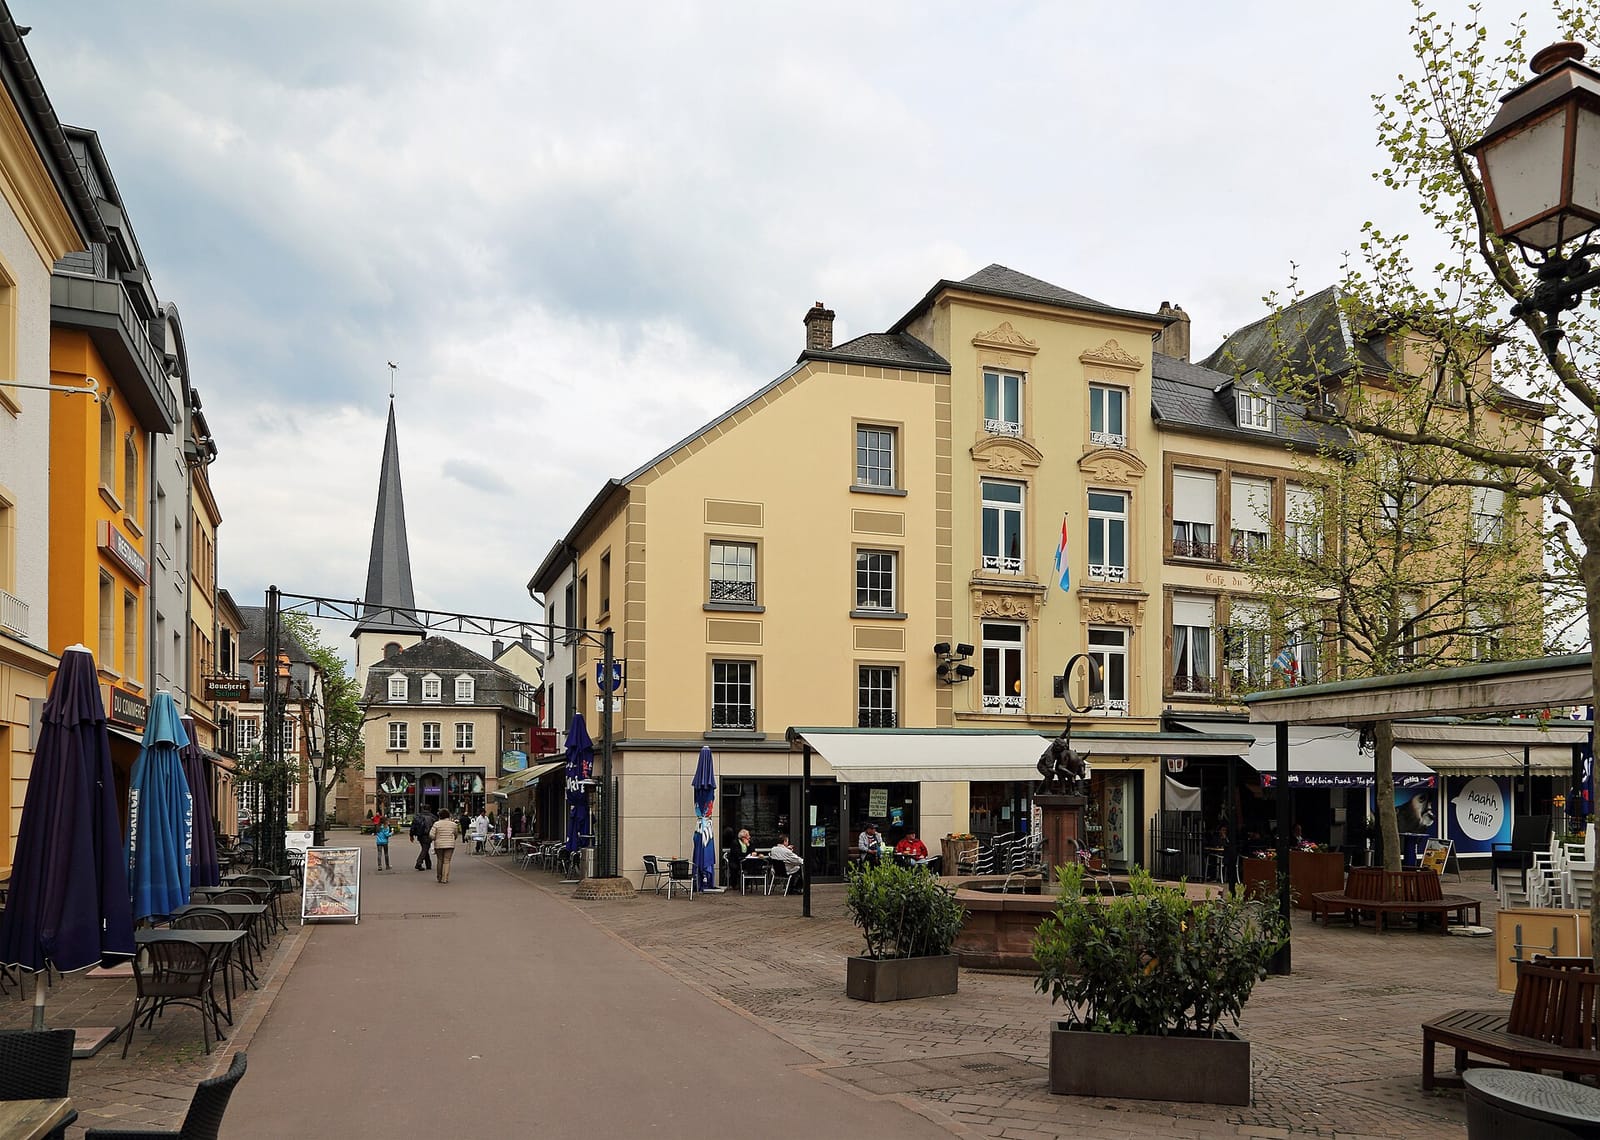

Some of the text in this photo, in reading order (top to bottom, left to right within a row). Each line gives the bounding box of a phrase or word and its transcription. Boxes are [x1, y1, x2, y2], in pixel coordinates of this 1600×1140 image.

[117, 535, 145, 577] RESTAURANT
[208, 682, 246, 690] Boucherie
[114, 695, 146, 720] DU COMMERCE
